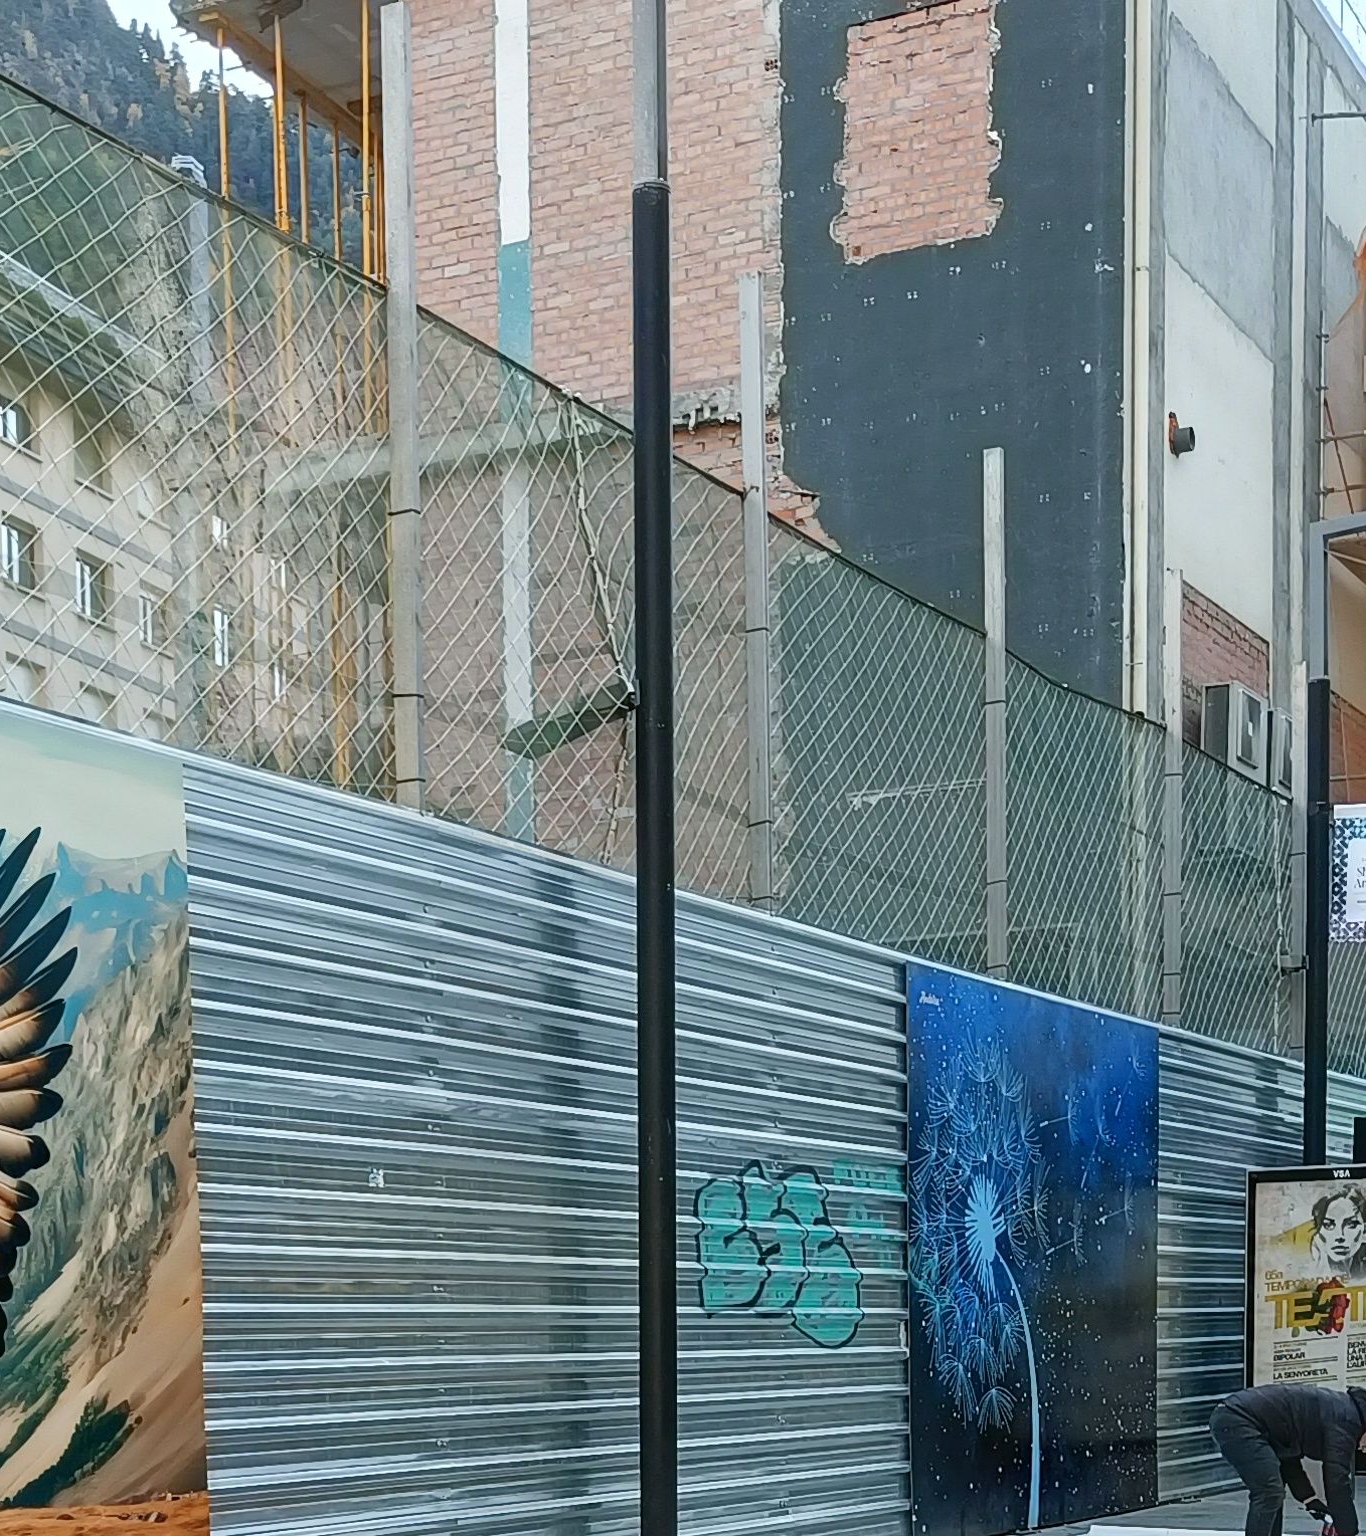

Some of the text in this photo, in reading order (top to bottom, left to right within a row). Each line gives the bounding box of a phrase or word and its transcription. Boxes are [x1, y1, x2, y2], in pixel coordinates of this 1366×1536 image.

[1273, 1352, 1306, 1361] BIPOLAR
[1273, 1371, 1283, 1380] LA
[1284, 1368, 1329, 1379] SENYORETA
